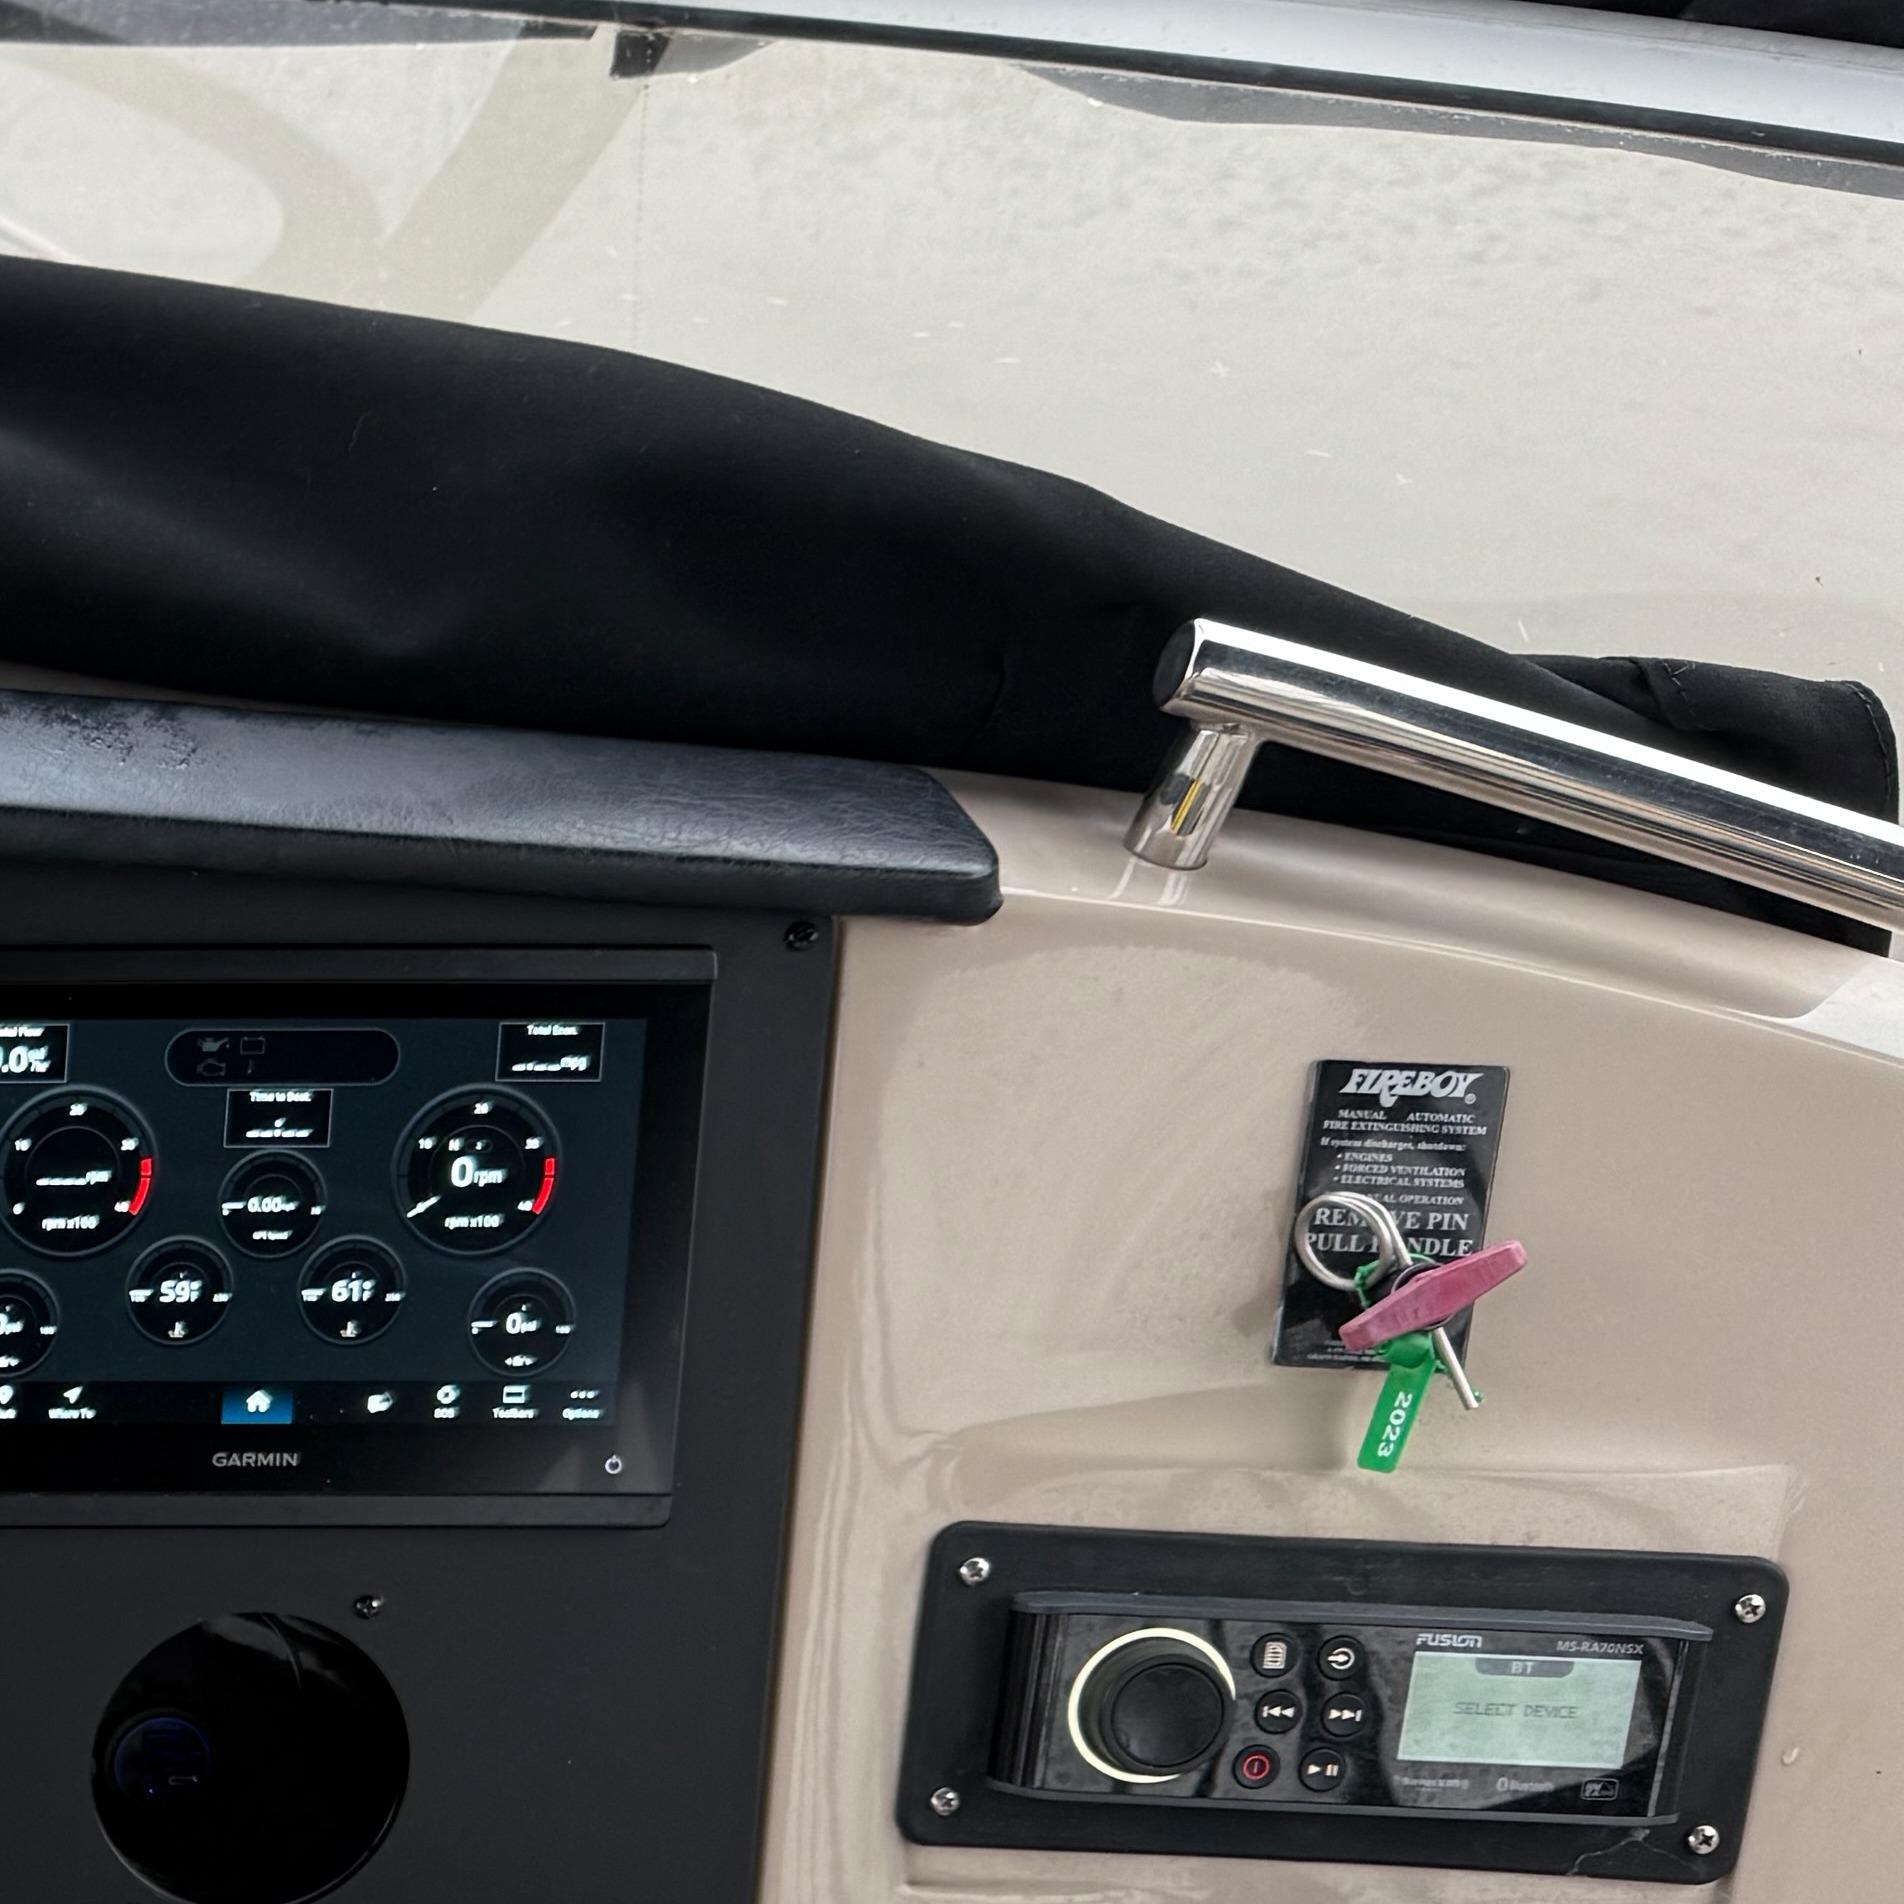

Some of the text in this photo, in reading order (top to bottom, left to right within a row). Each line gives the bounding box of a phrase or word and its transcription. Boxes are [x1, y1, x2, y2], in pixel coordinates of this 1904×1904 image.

[1339, 1068, 1484, 1107] FIREBOY
[1338, 1109, 1476, 1124] MANUAL AUTOMATIC
[1323, 1120, 1487, 1135] FIRE EXTINGUISHING SYSTEM
[1343, 1152, 1393, 1163] ENGINES
[1343, 1163, 1466, 1177] FORCED VENTILATION
[1341, 1174, 1465, 1188] ELECTRICAL SYSTEMS
[1399, 1193, 1464, 1206] OPERATION
[1314, 1207, 1470, 1231] REMVE PIN
[1307, 1232, 1365, 1252] PULL
[1377, 1391, 1413, 1457] 2023
[213, 1453, 300, 1468] GARMIN
[1416, 1633, 1482, 1648] FUSION
[1510, 1661, 1535, 1674] BT
[1453, 1702, 1580, 1719] SELECT DEVICE
